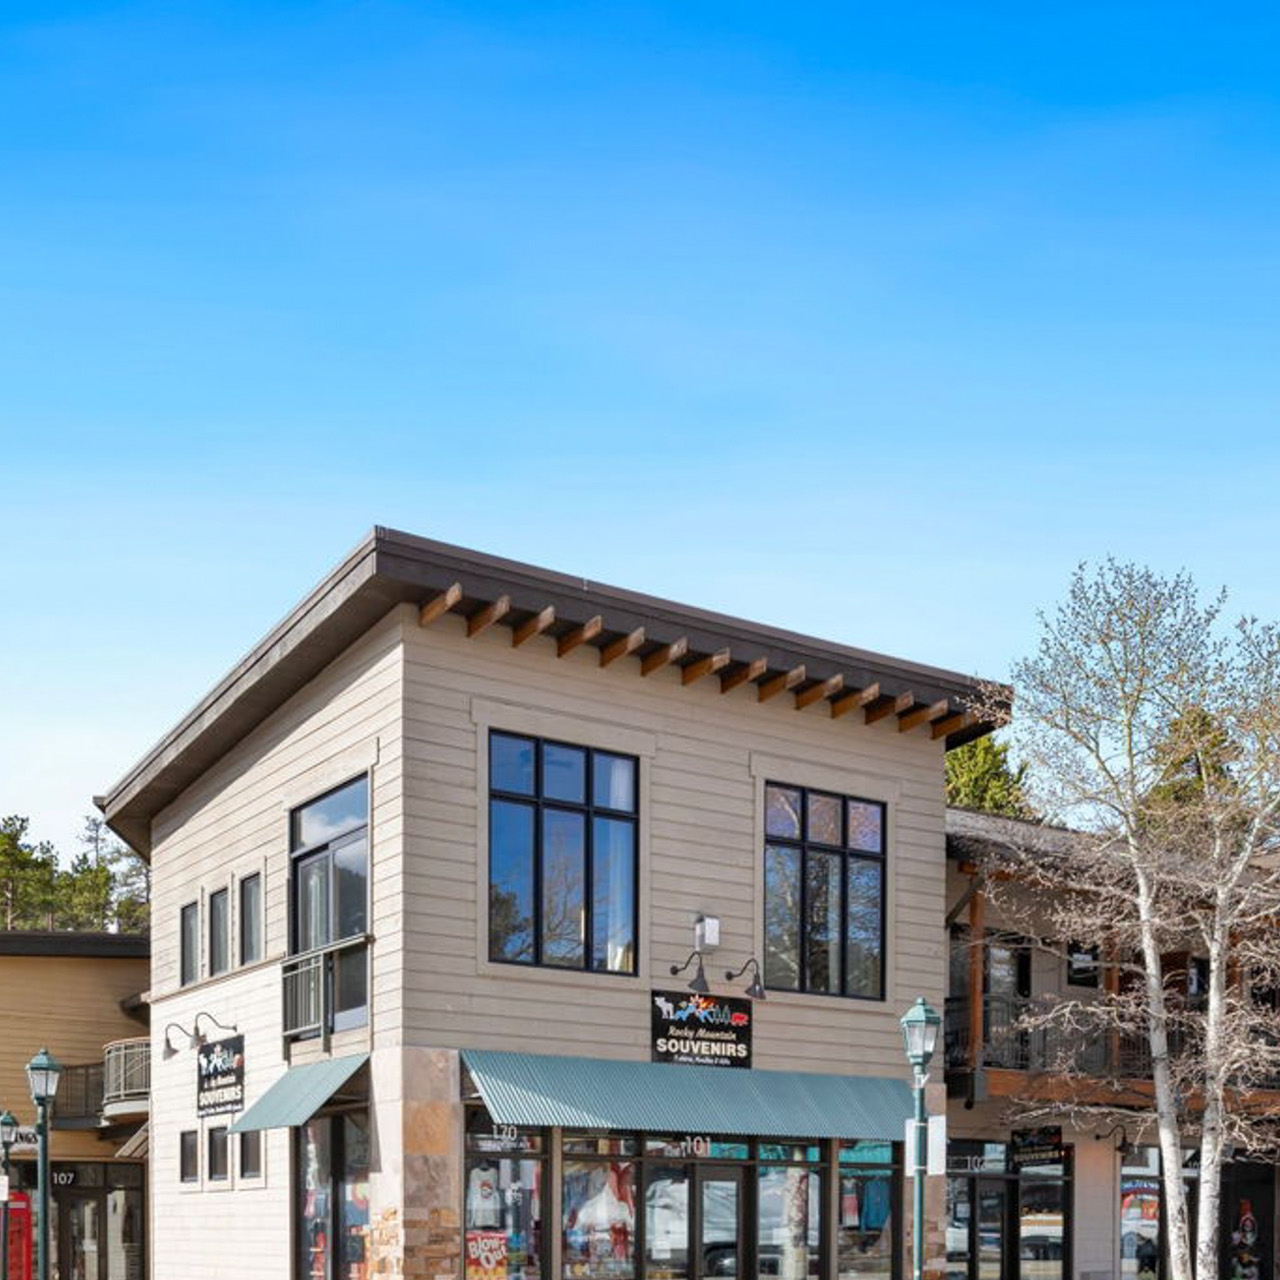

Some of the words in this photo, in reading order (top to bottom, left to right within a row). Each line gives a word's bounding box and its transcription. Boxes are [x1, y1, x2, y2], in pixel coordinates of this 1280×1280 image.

[656, 1038, 748, 1057] SOUVENIRS
[685, 1136, 711, 1156] 101
[52, 1172, 74, 1185] 107
